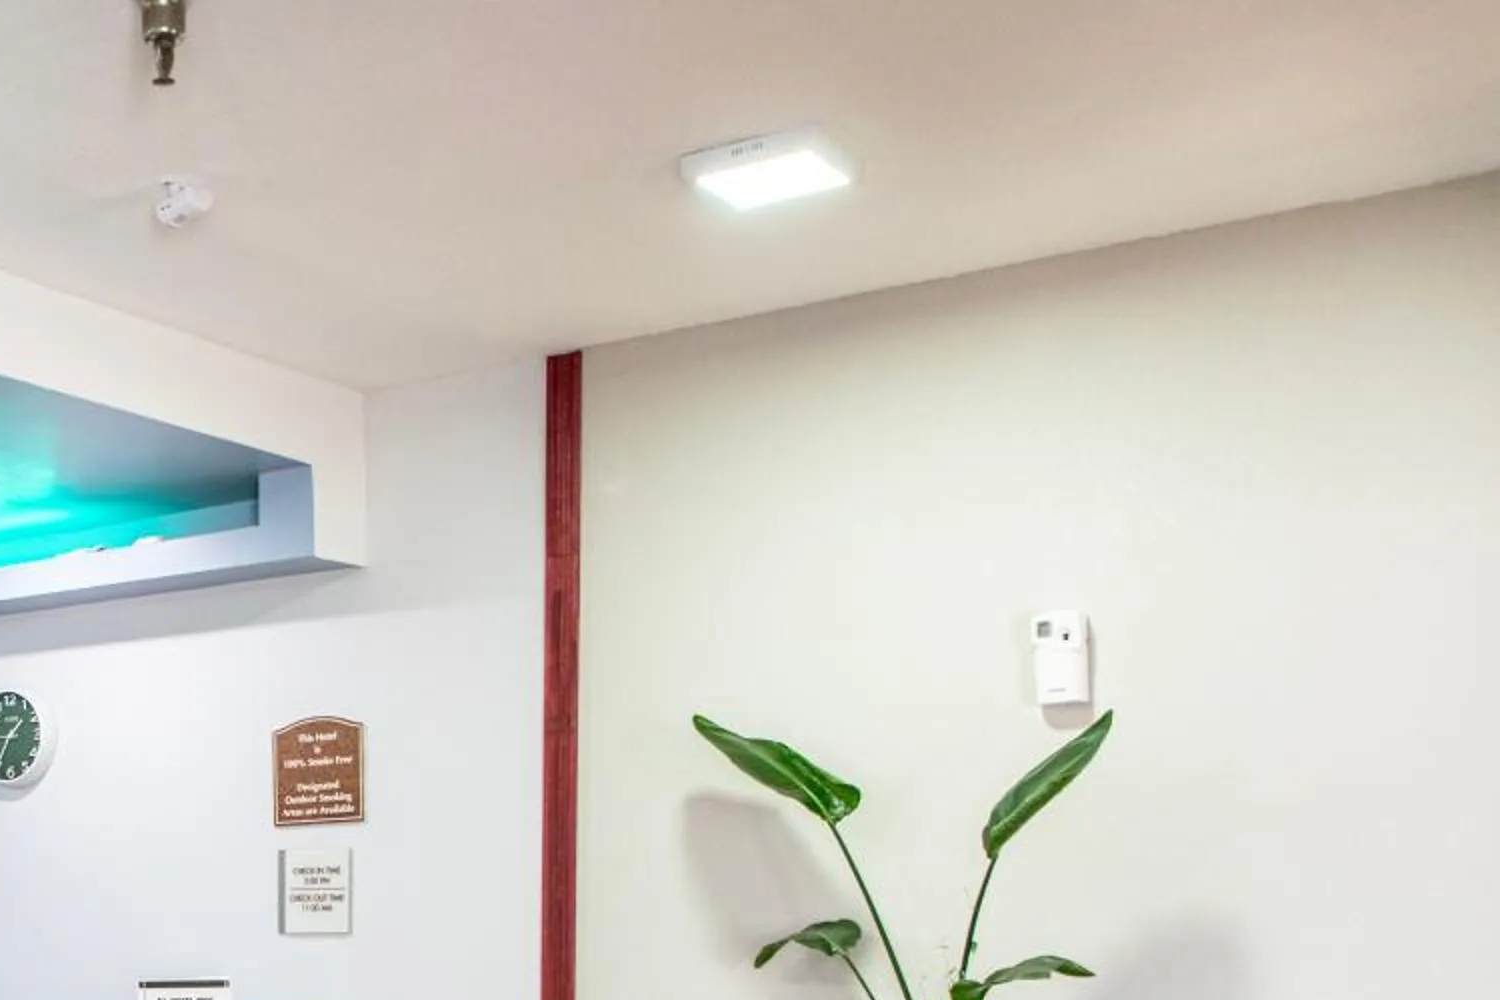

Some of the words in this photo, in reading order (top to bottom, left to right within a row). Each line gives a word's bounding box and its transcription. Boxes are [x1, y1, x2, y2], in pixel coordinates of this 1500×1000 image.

[3, 694, 17, 706] 12
[22, 700, 27, 710] 1
[298, 733, 314, 742] This
[316, 731, 337, 741] Hotel
[6, 765, 15, 779] 6
